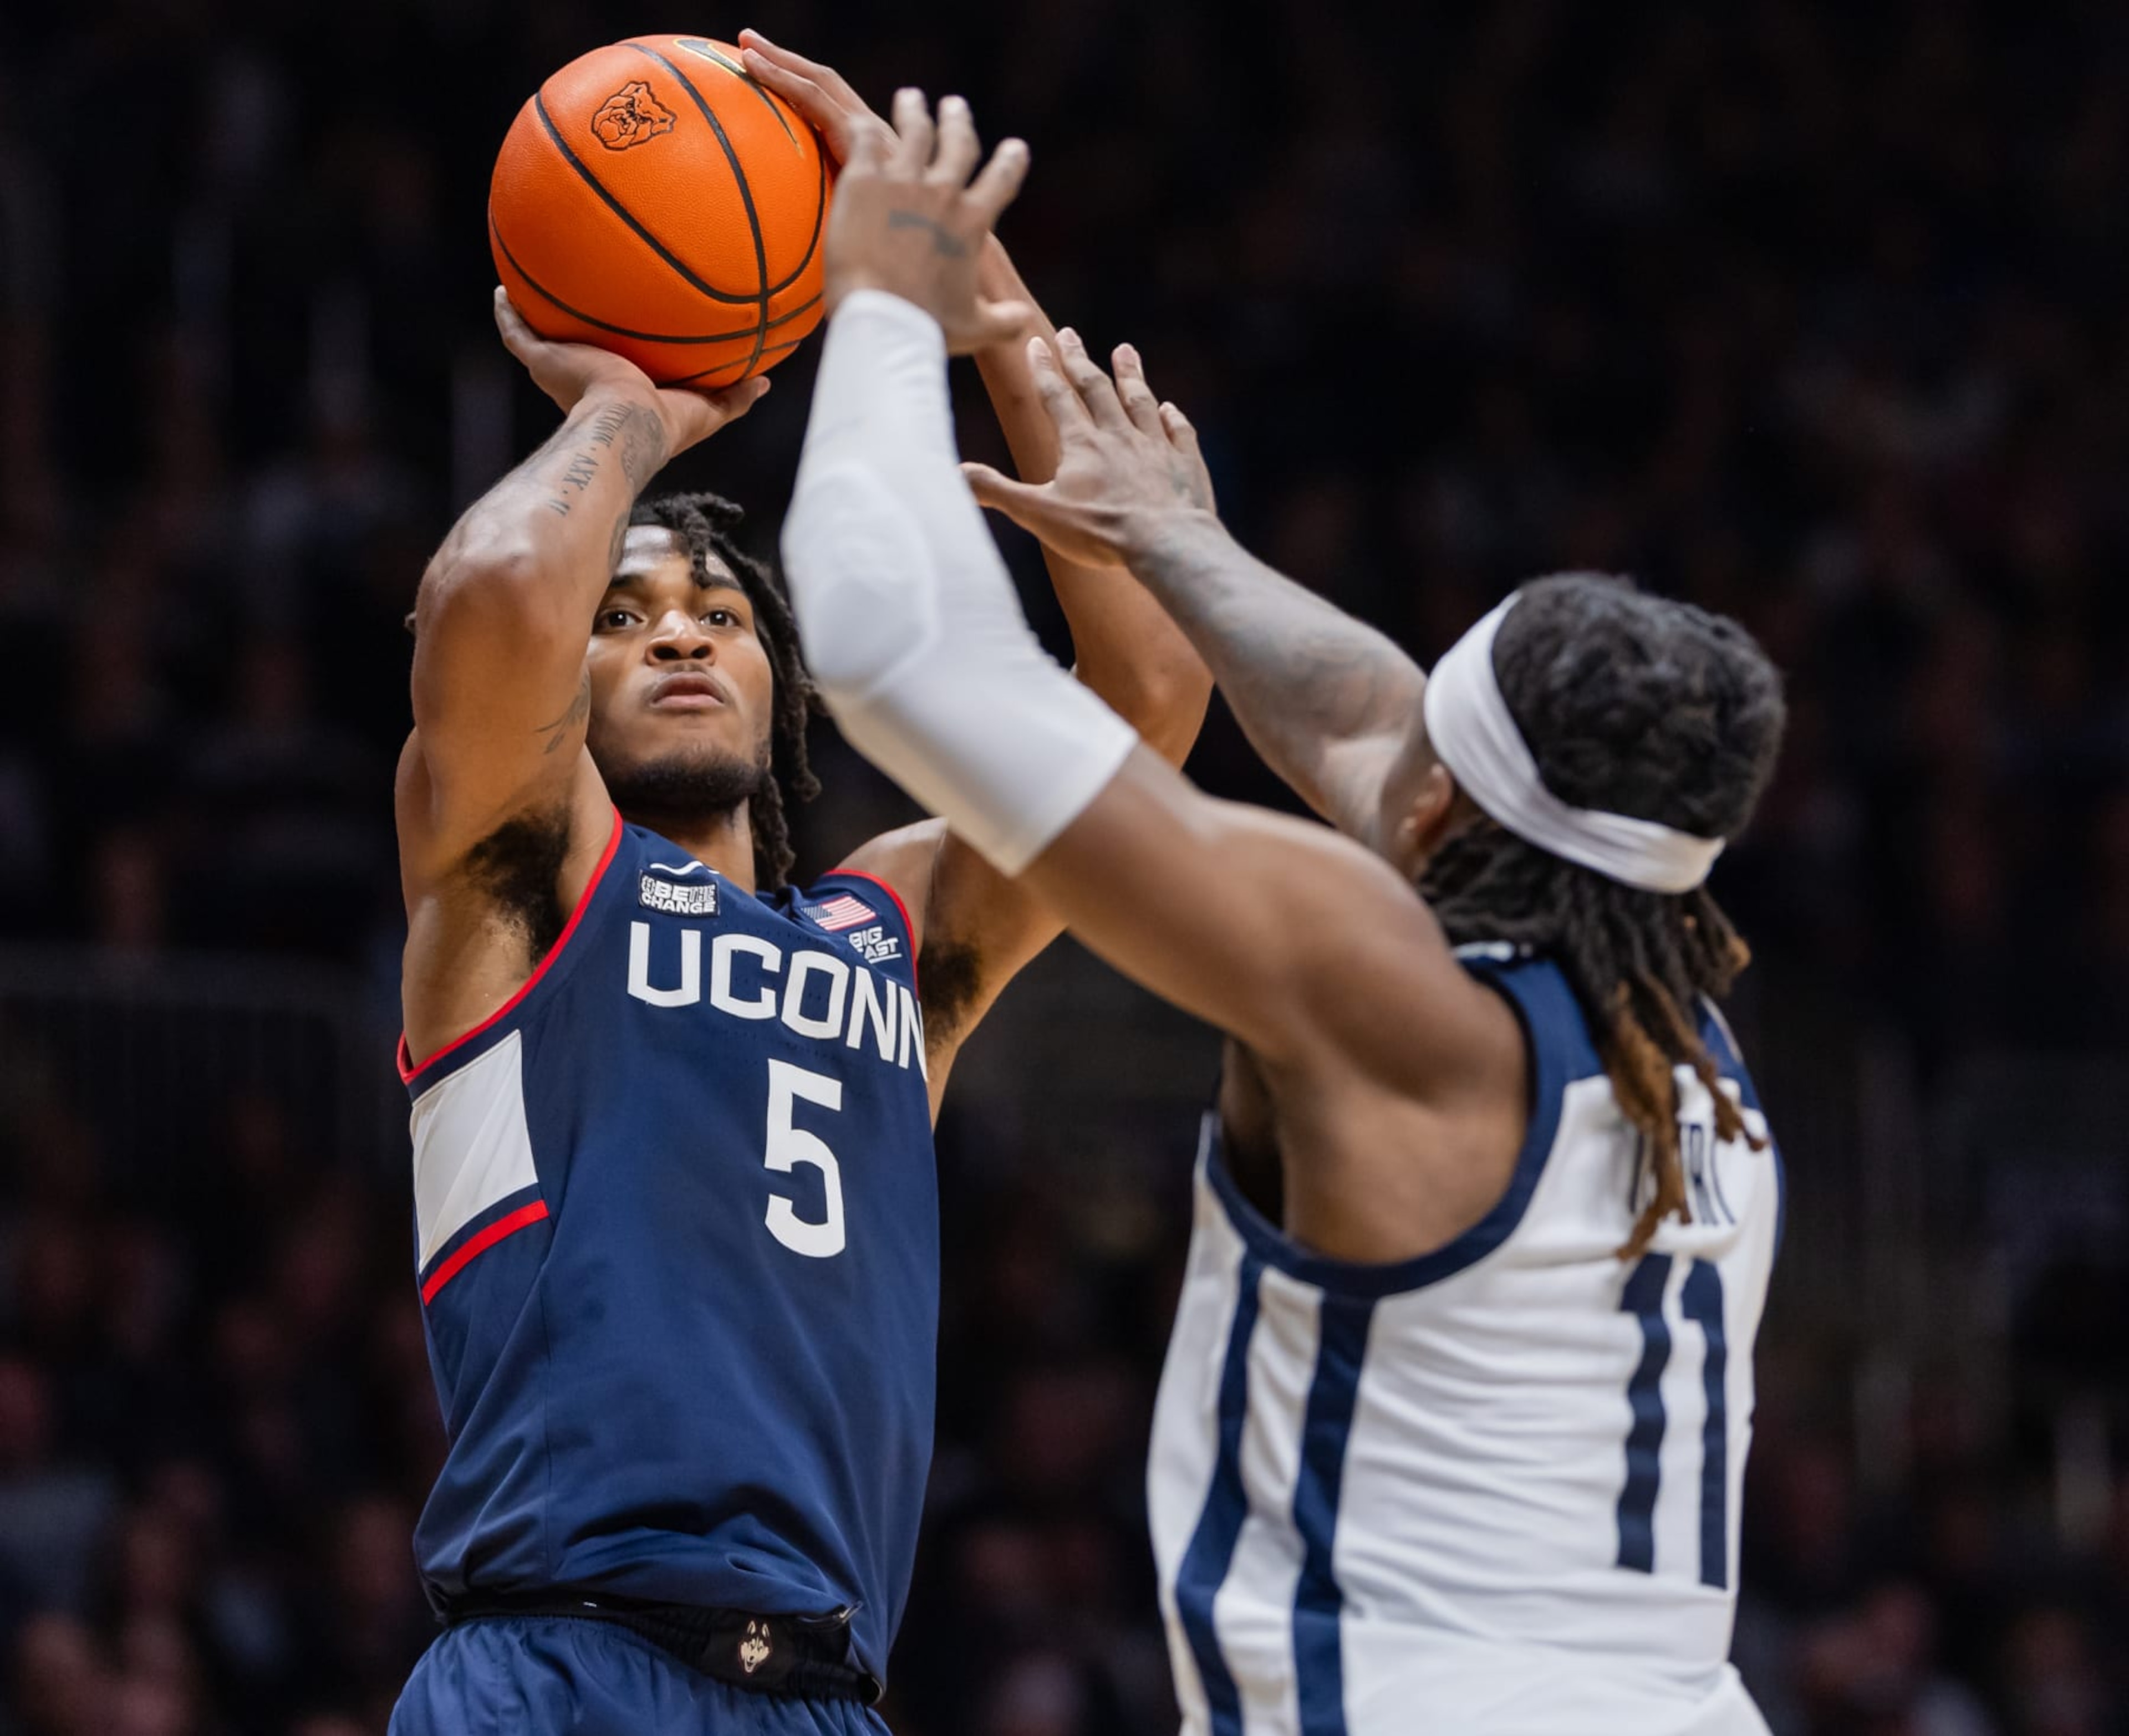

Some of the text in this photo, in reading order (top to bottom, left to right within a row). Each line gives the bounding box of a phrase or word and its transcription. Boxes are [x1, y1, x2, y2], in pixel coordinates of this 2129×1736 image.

[641, 892, 716, 914] CHANGE
[849, 926, 883, 949] BIG
[628, 921, 928, 1082] UCONN
[765, 1058, 846, 1258] 5
[1614, 1251, 1728, 1590] 11
